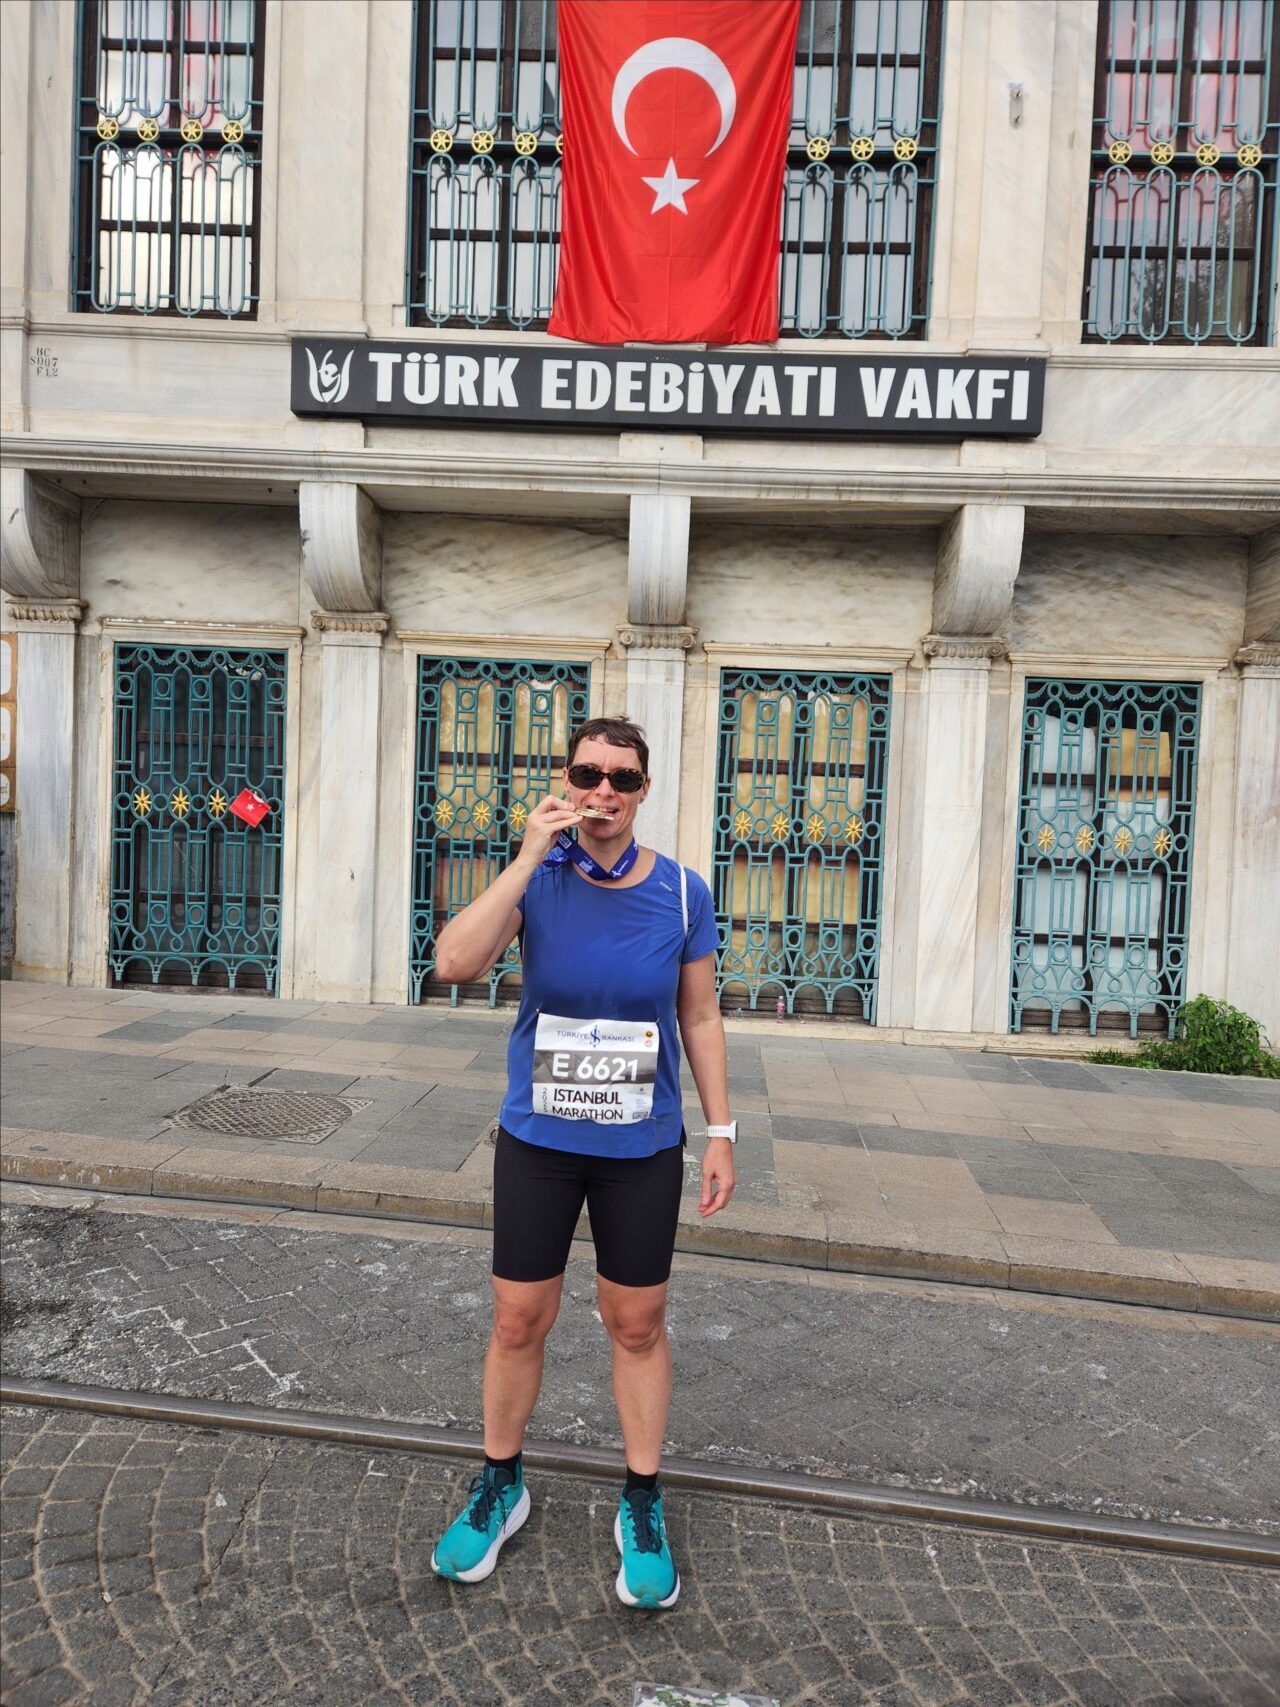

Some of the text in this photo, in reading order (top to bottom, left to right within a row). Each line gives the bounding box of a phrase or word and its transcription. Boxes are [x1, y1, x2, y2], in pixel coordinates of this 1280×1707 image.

[369, 352, 520, 407] TÜRK
[859, 367, 1030, 420] VAKFI
[552, 1052, 638, 1081] E 6621
[553, 1088, 623, 1105] ISTANBUL
[552, 1105, 623, 1120] MARATHON
